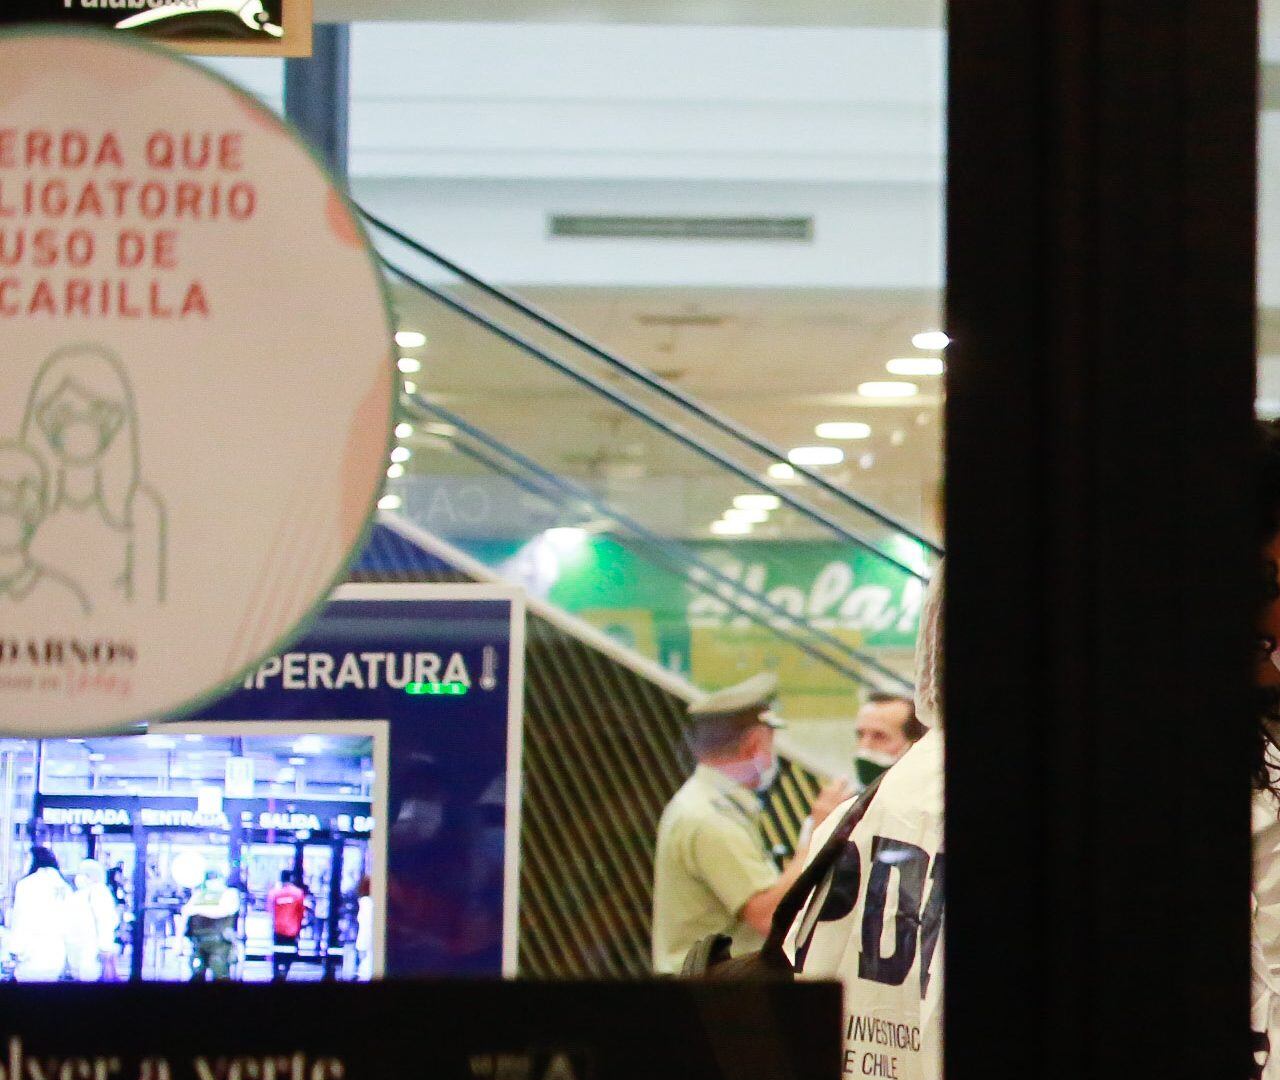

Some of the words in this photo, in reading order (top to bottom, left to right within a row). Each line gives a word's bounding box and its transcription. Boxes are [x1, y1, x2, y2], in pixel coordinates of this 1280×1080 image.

[146, 130, 243, 171] QUE
[117, 230, 177, 271] DE
[861, 1052, 899, 1080] CHILE
